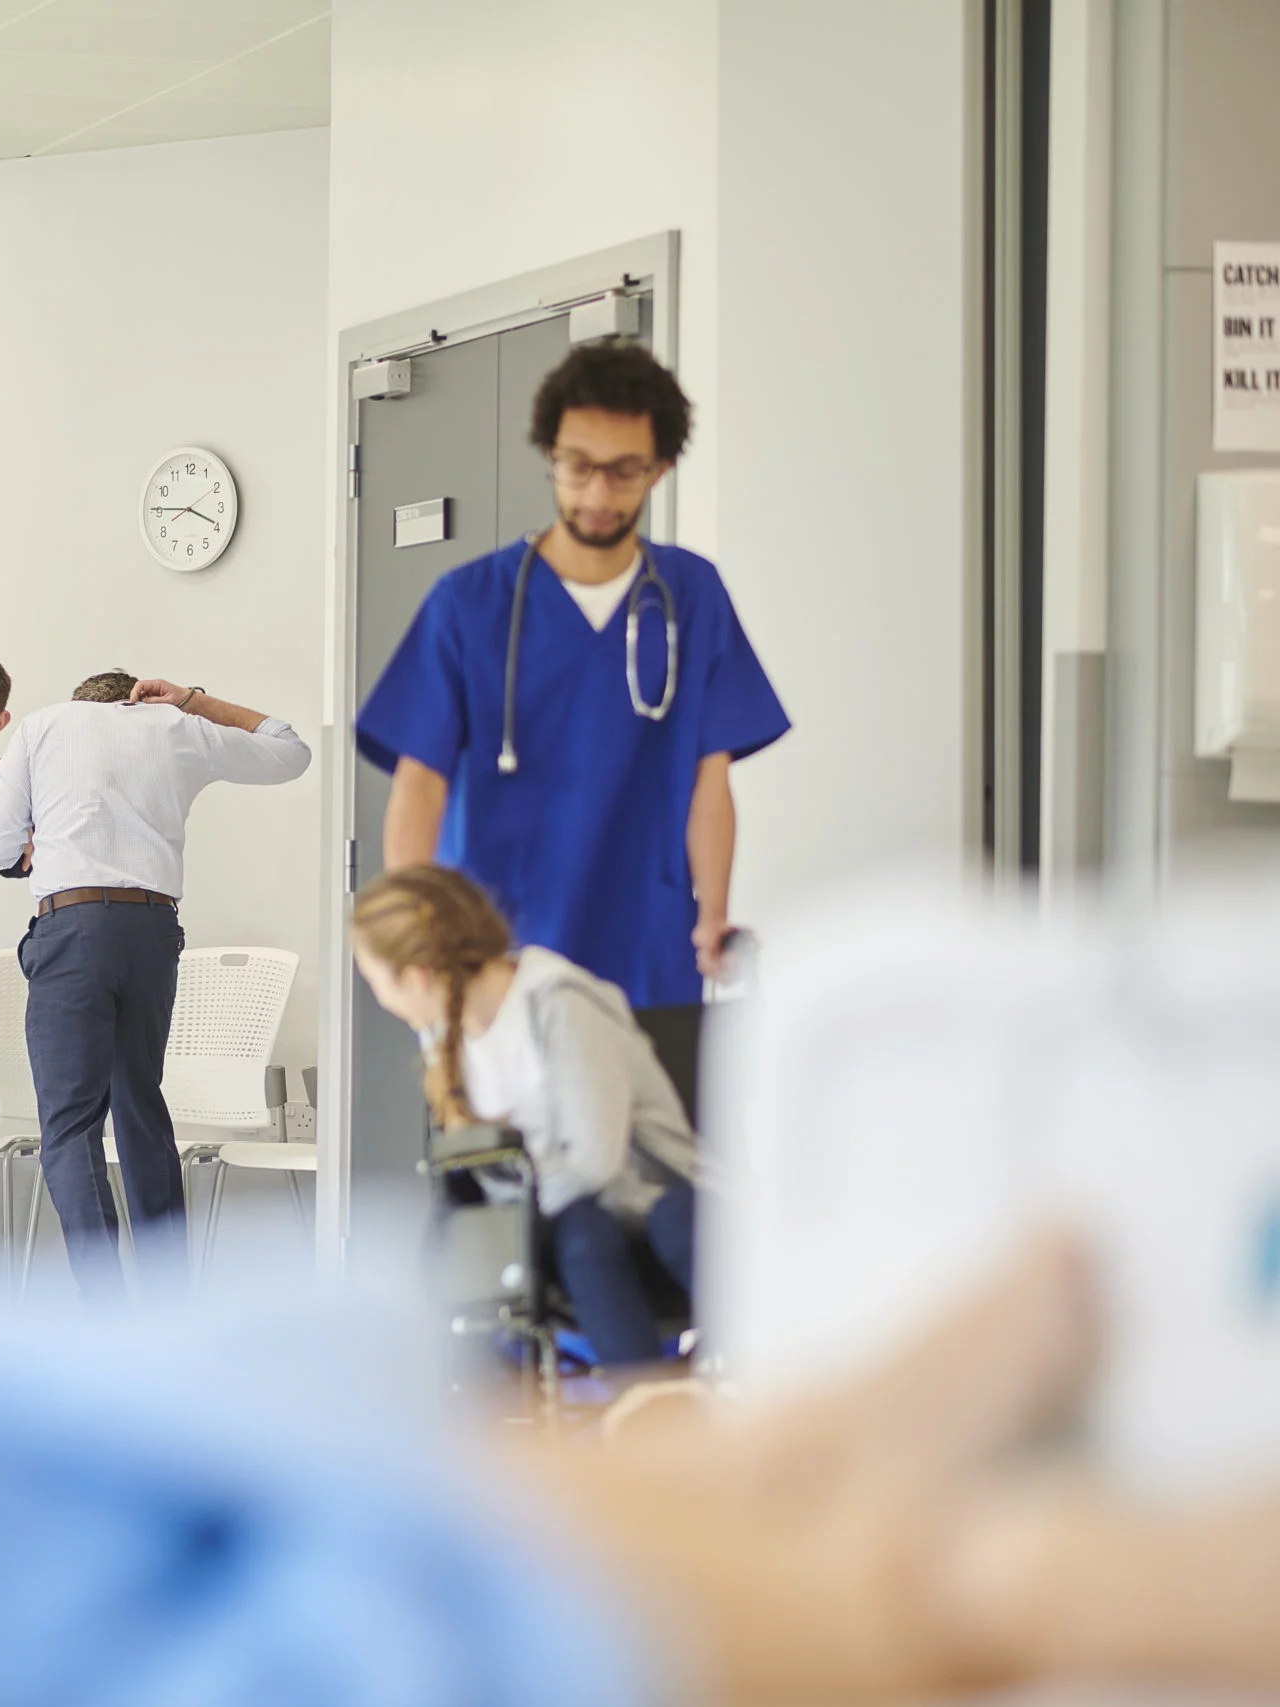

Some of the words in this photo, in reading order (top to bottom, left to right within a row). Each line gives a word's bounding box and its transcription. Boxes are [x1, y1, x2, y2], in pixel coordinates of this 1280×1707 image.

[1224, 264, 1279, 286] CATCH
[1223, 316, 1251, 337] BIN
[1260, 317, 1275, 338] IT
[1223, 369, 1260, 390] KILL
[1266, 369, 1280, 390] IT
[185, 463, 196, 475] 12
[203, 467, 208, 480] 1
[170, 470, 180, 482] 11
[159, 485, 169, 497] 10
[213, 482, 221, 494] 2
[156, 506, 163, 519] 9
[217, 501, 224, 513] 3
[160, 526, 167, 538] 8
[213, 522, 221, 534] 4
[171, 540, 179, 552] 7
[202, 537, 209, 550] 5
[186, 544, 194, 556] 6
